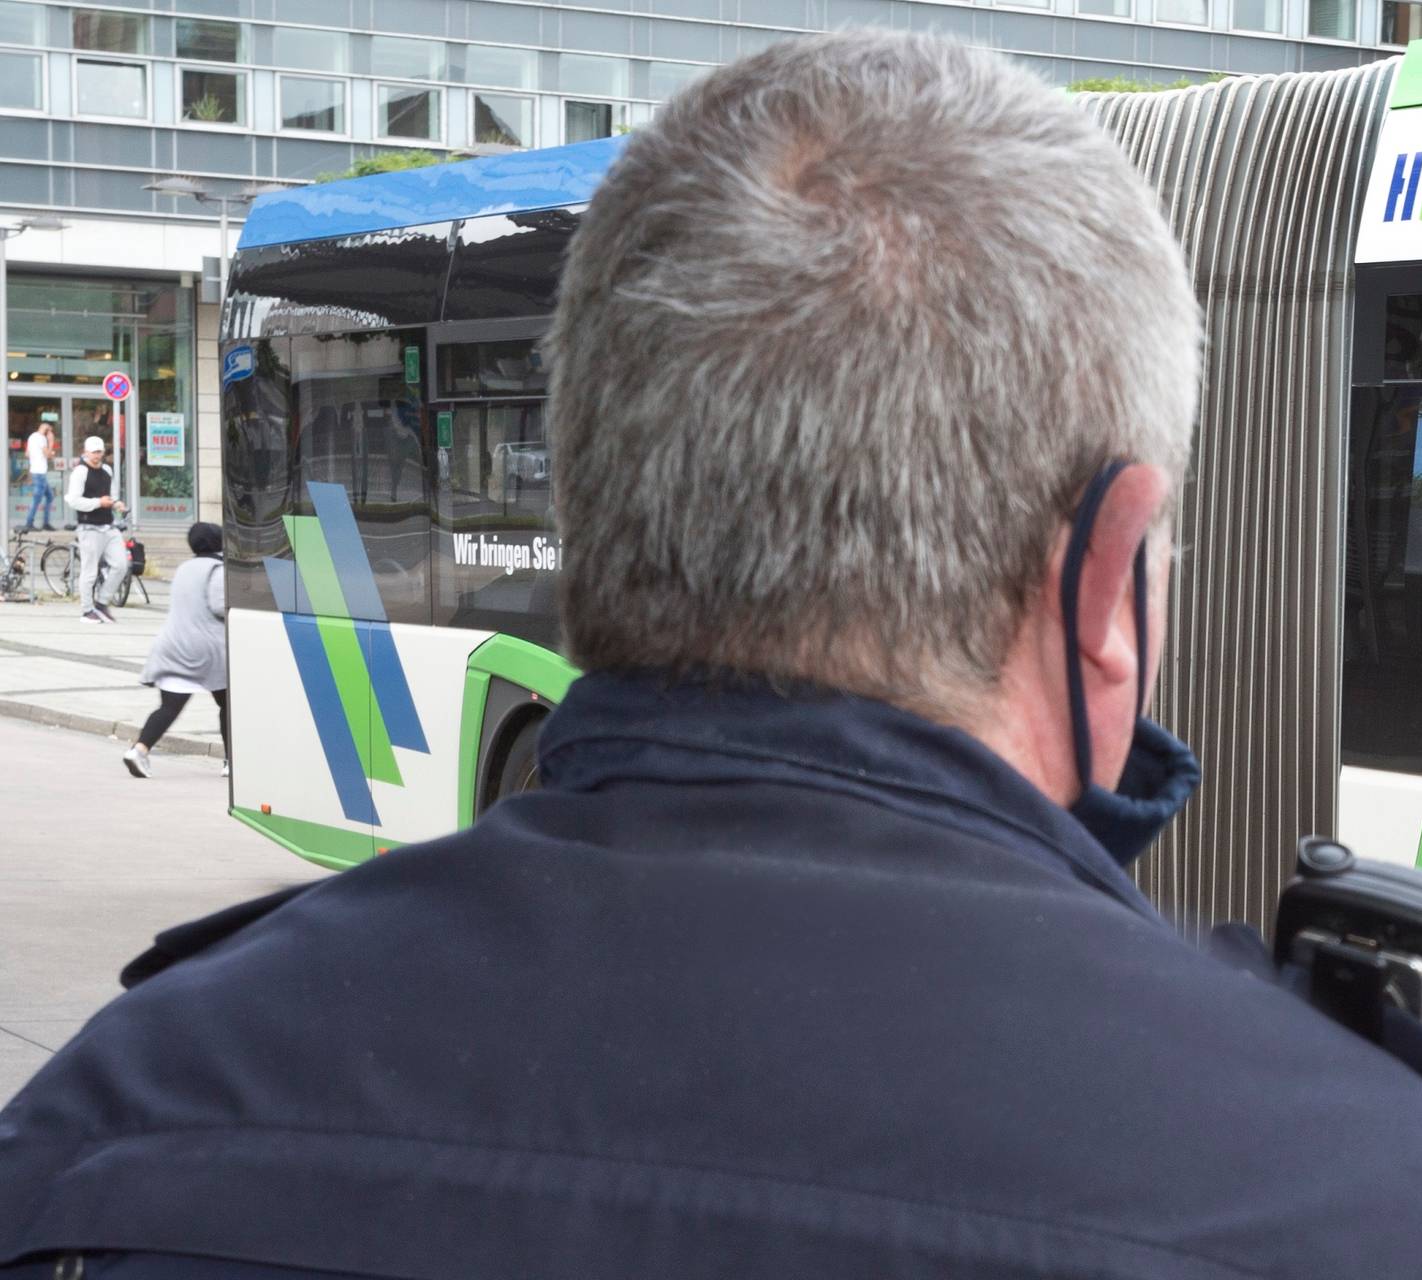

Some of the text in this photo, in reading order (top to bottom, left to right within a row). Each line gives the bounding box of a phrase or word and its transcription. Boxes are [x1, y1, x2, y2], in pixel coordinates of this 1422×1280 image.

[453, 533, 563, 576] Wir bringen Sie i
